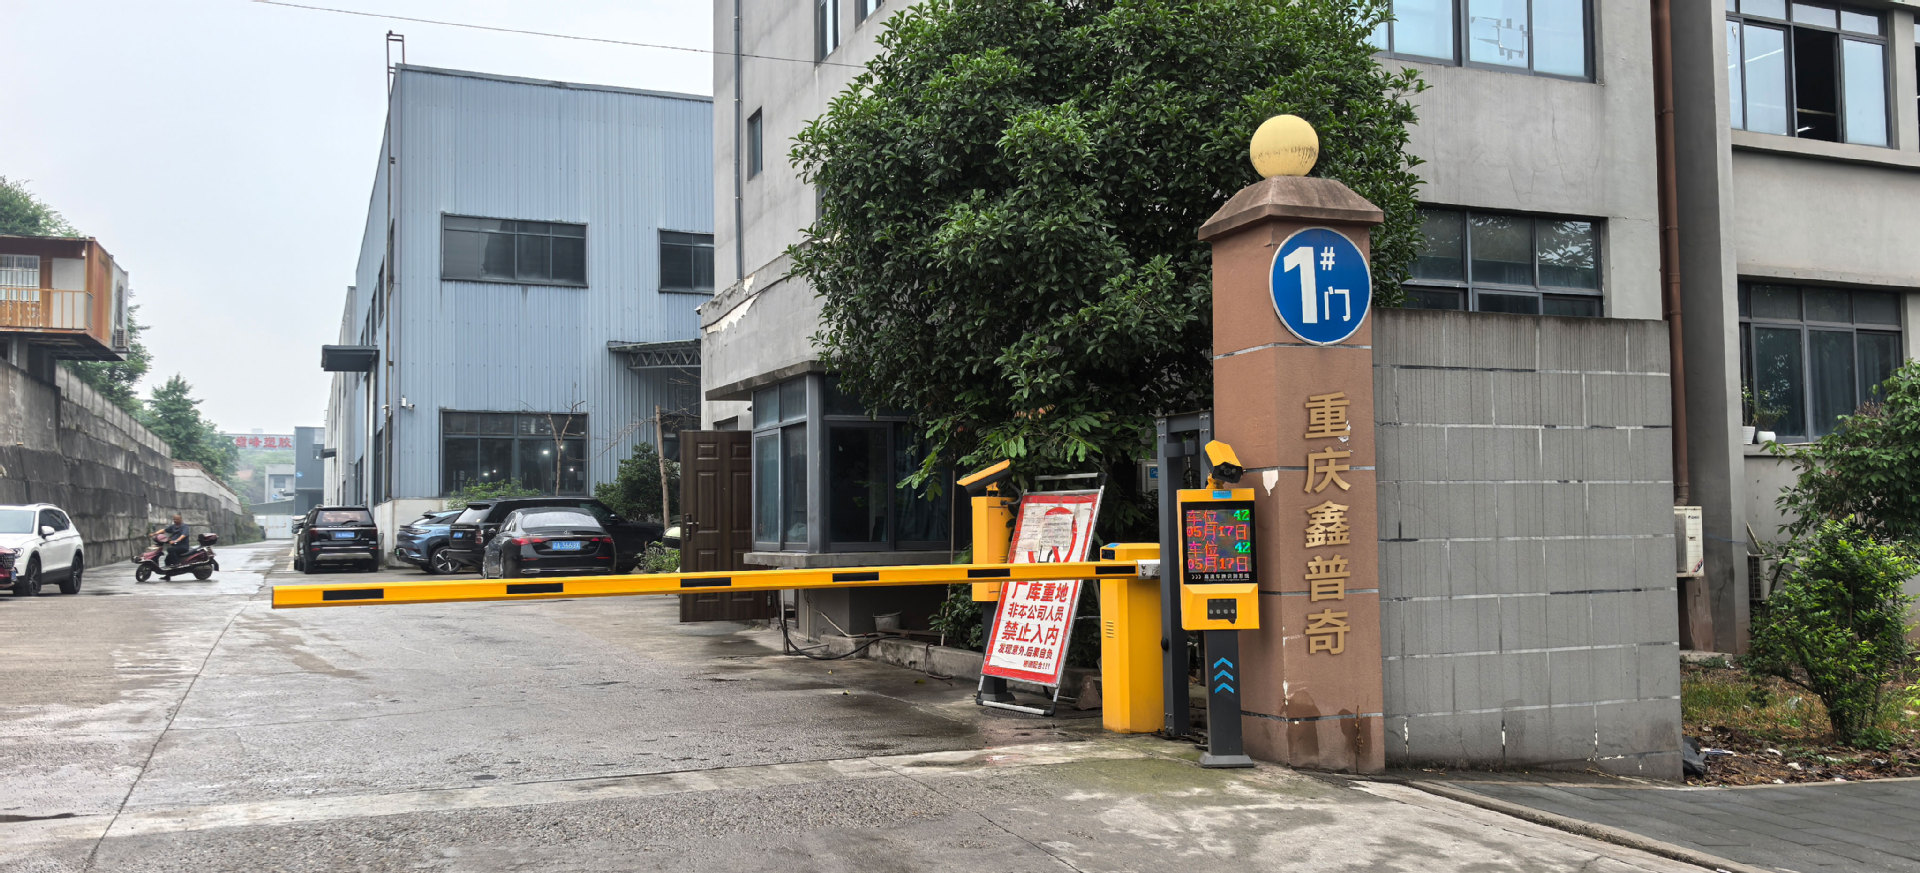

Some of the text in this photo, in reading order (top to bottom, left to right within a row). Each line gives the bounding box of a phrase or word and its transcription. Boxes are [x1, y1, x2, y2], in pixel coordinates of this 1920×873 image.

[1186, 509, 1250, 526] 车位 42
[1304, 391, 1351, 655] 重庆鑫普奇
[1186, 524, 1247, 541] 05月17日
[1188, 541, 1251, 557] 车位 42
[1187, 556, 1249, 573] 05月17日
[1007, 601, 1064, 622] 非本公司人员
[1001, 620, 1060, 646] 禁止入内
